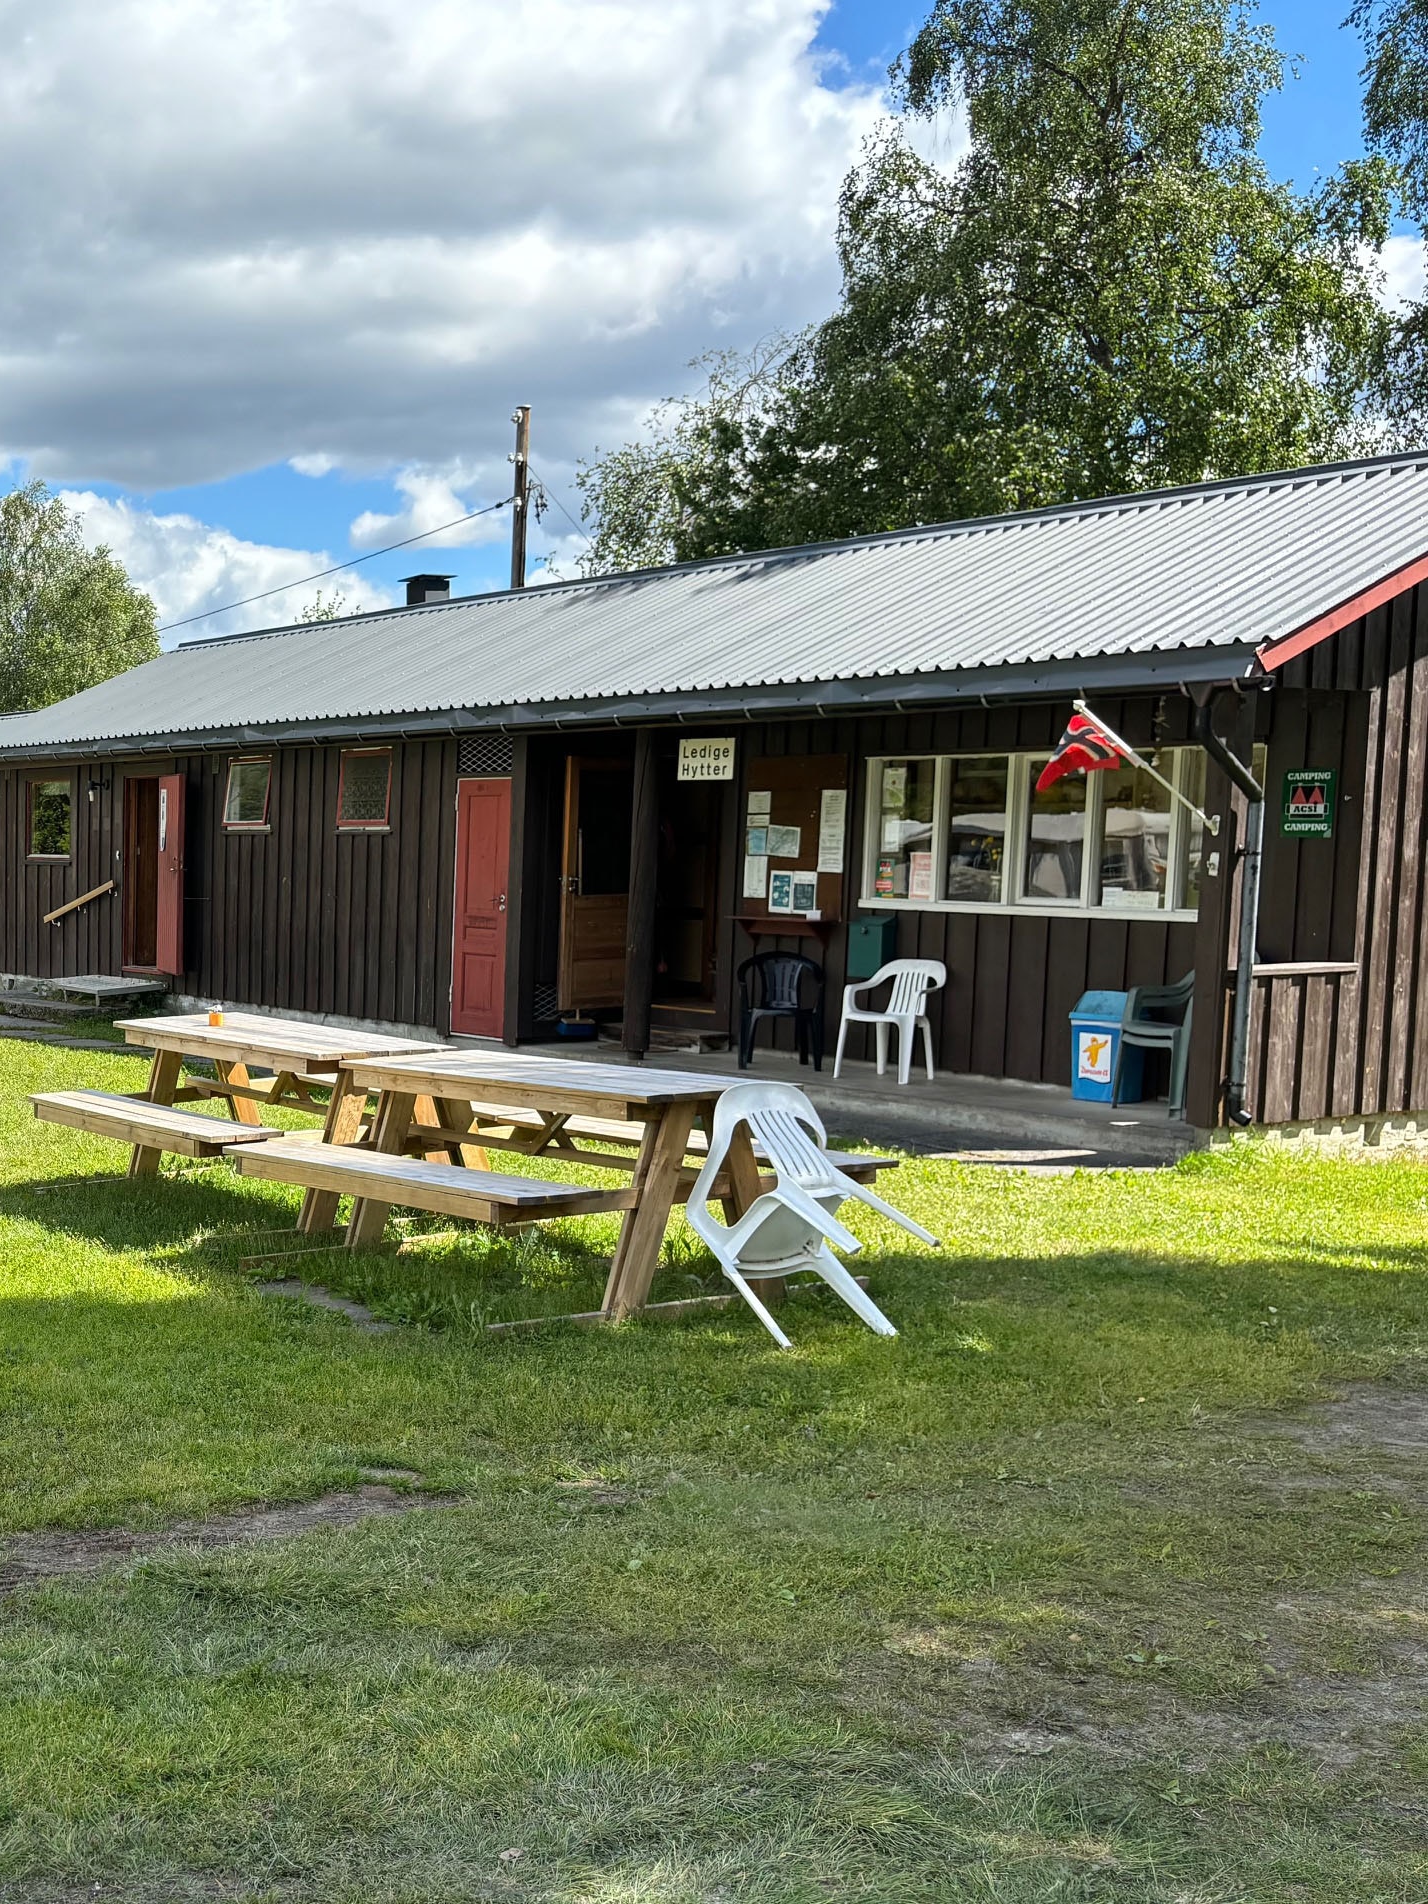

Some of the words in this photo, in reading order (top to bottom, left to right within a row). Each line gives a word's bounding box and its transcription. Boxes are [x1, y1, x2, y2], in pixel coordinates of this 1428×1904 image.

[683, 745, 730, 761] Ledige
[682, 763, 727, 779] Hytter
[1287, 771, 1332, 781] CAMPING
[1283, 823, 1328, 832] CAMPING
